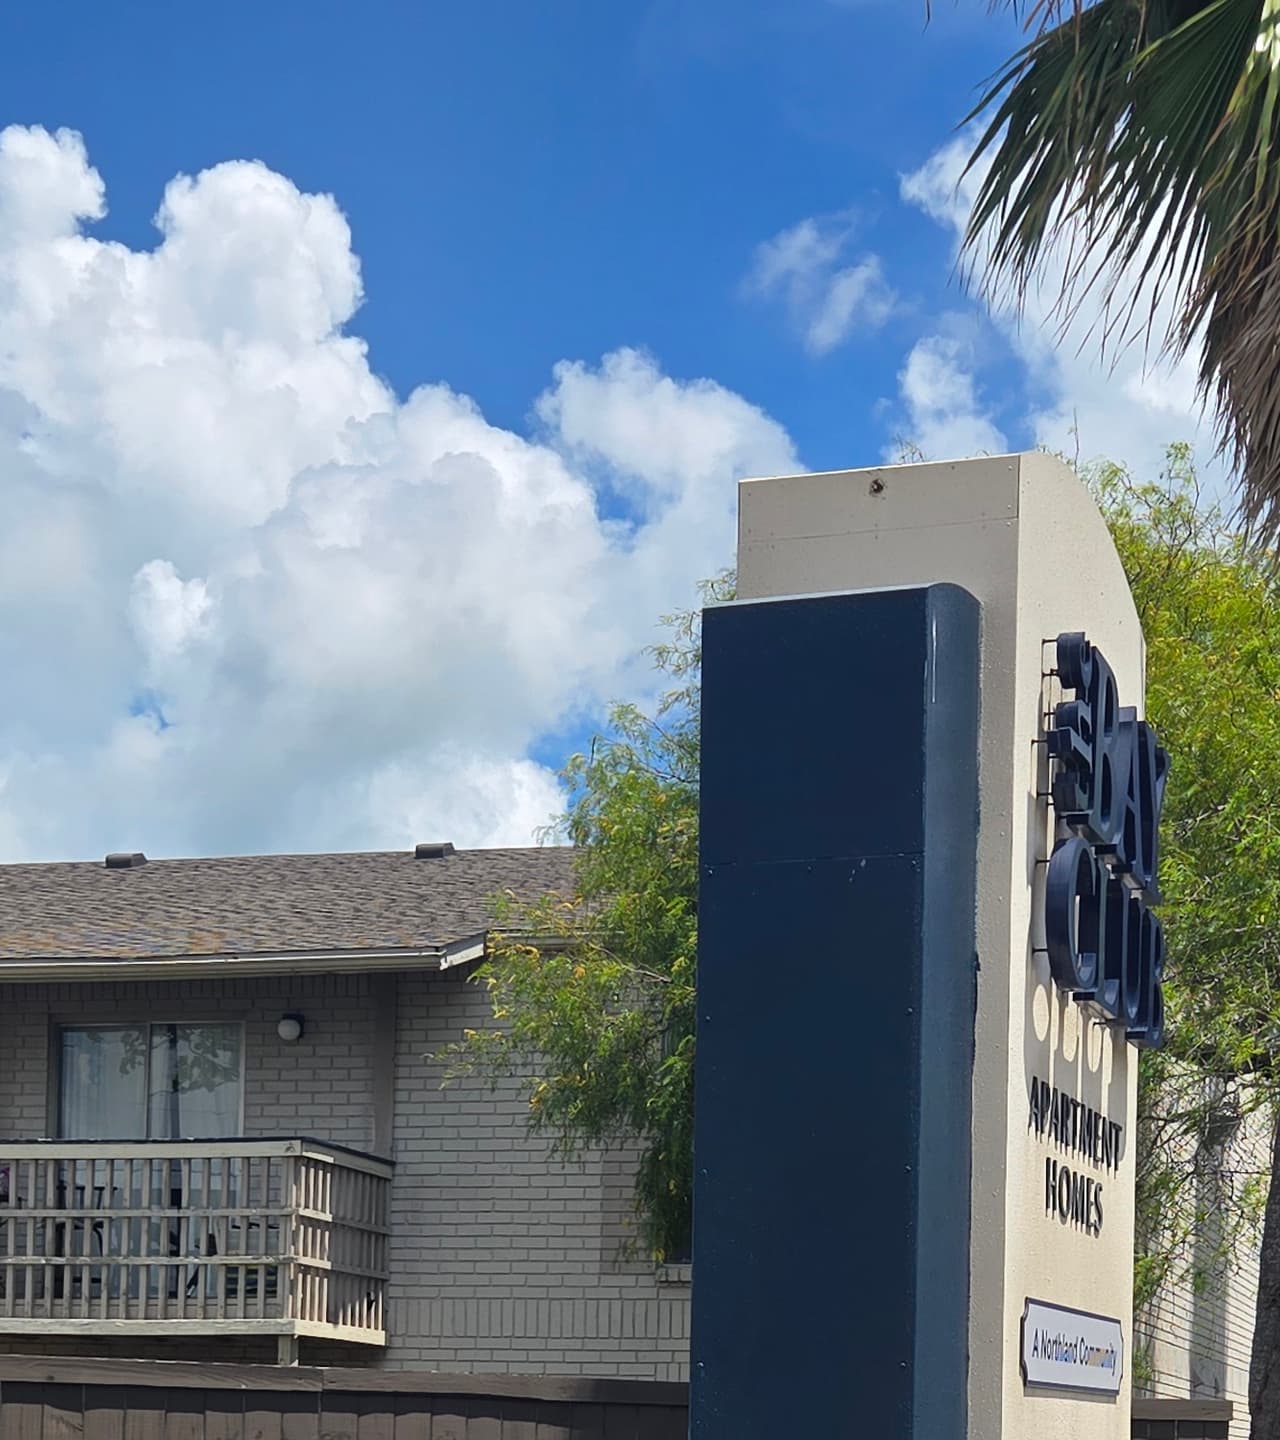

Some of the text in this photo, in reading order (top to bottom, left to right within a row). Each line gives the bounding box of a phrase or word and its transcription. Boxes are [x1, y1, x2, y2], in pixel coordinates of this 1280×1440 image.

[1084, 645, 1169, 900] BAY
[1046, 837, 1165, 1048] CLUB
[1028, 1075, 1123, 1174] APARTMENT
[1046, 1156, 1104, 1234] HOMES
[1031, 1327, 1116, 1376] A Northland Community
